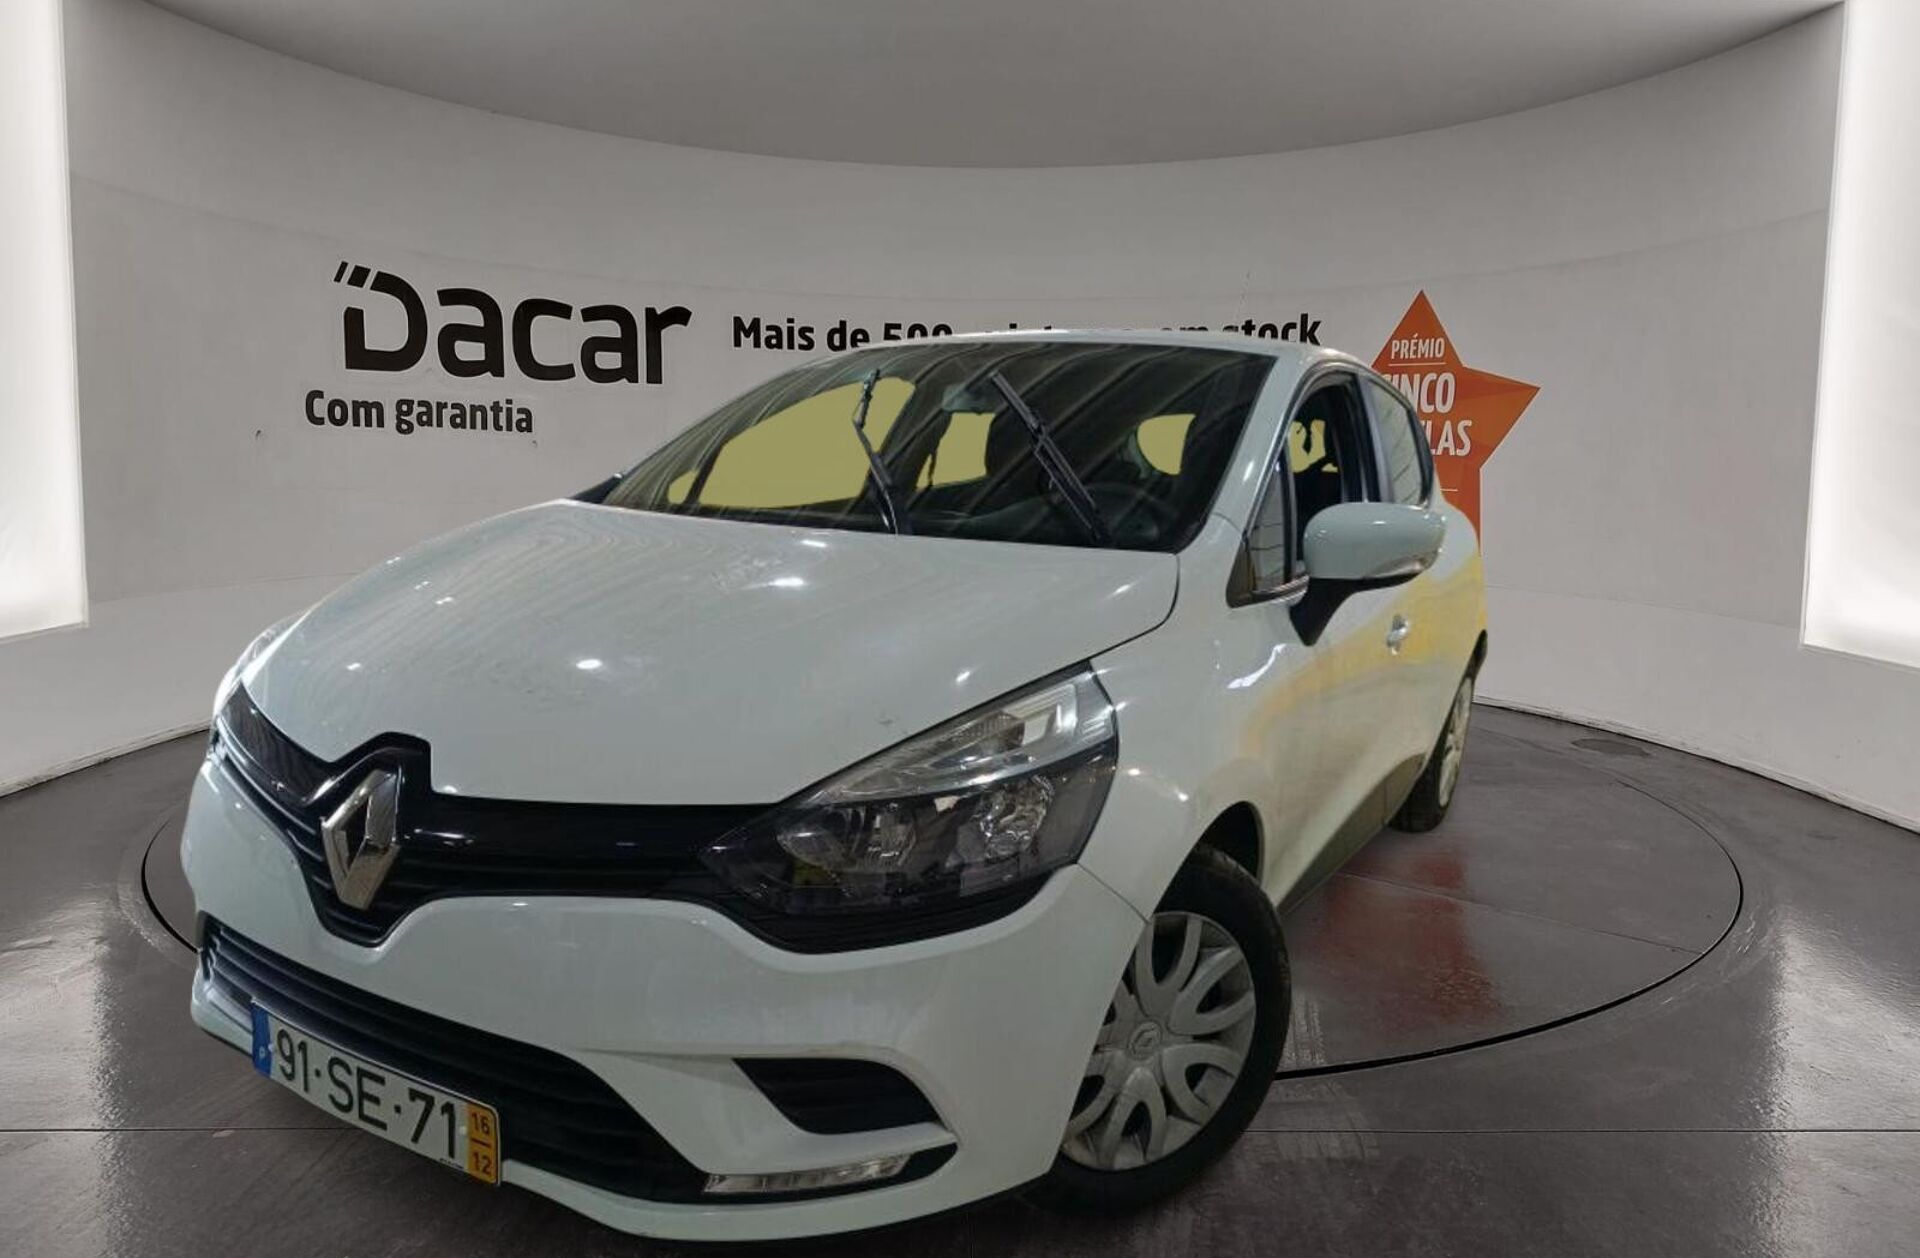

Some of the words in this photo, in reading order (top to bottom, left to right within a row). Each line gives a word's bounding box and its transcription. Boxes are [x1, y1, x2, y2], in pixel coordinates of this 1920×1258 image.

[334, 261, 692, 384] Dacar
[732, 315, 816, 351] Mais
[826, 319, 871, 352] de
[1222, 312, 1322, 347] tock
[1391, 333, 1446, 360] PRÉMIO
[304, 389, 385, 426] Com
[394, 397, 534, 435] garantia
[1381, 372, 1456, 414] NCO
[470, 1112, 491, 1136] 16
[472, 1151, 493, 1176] 12
